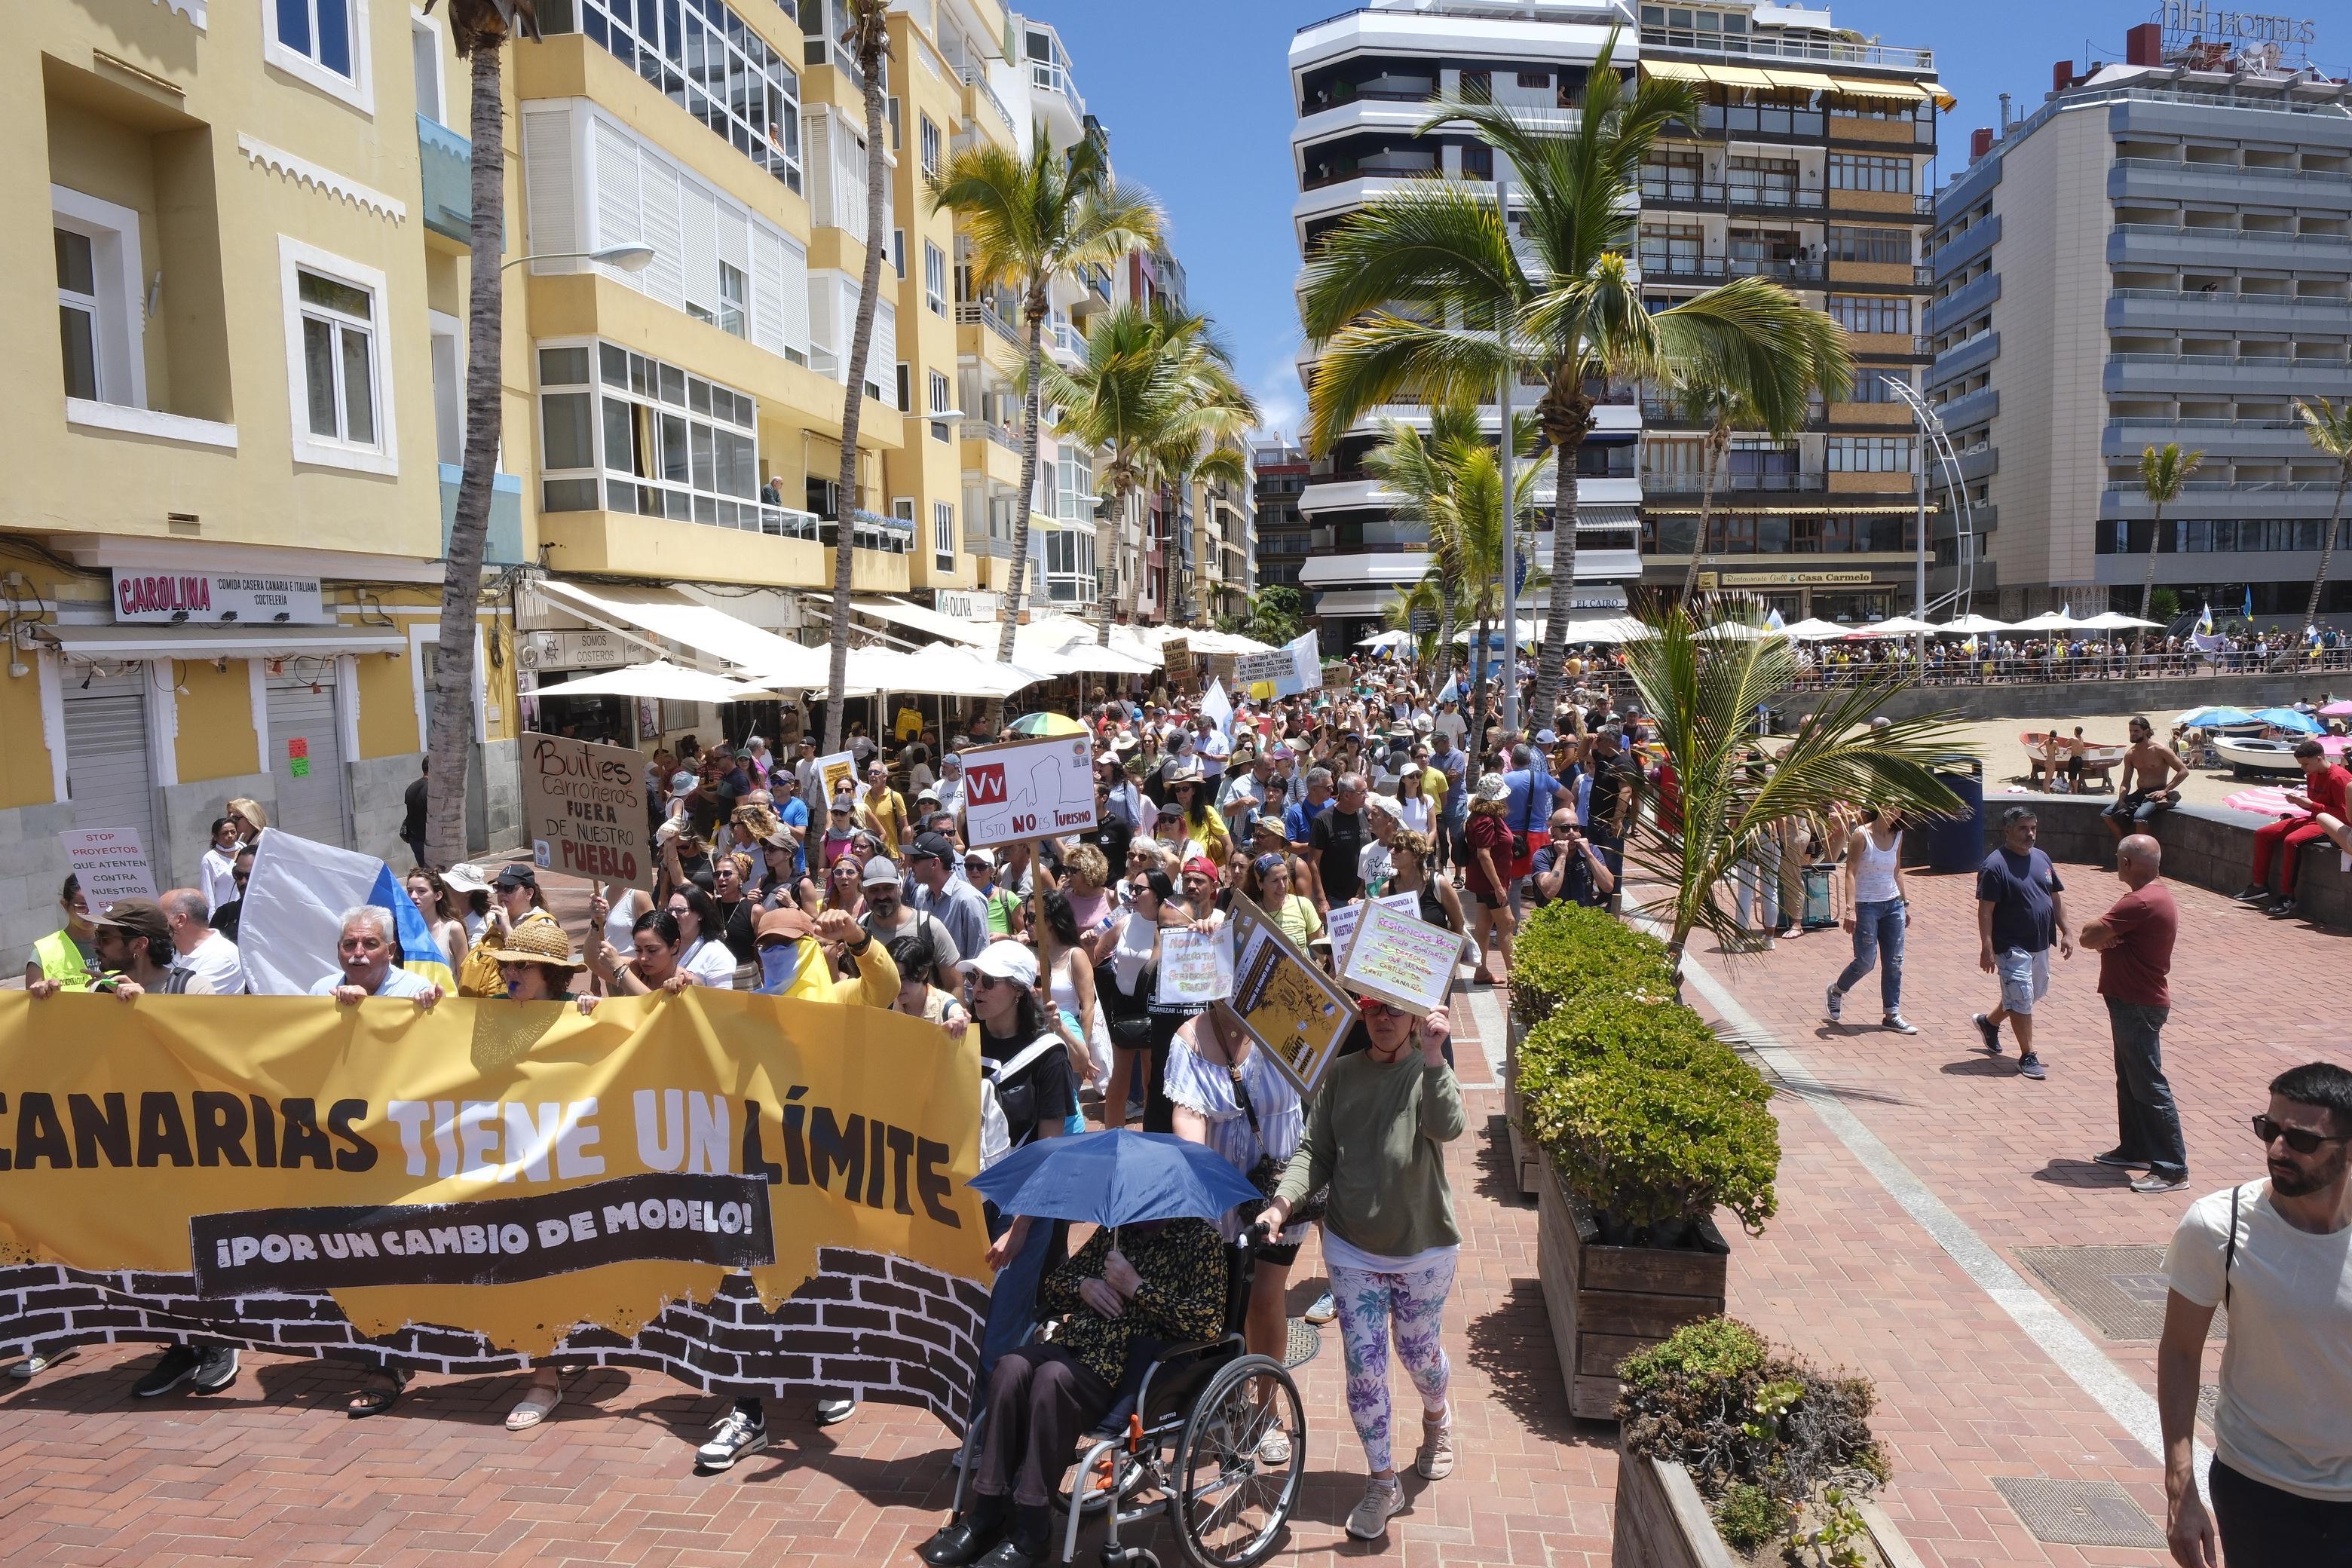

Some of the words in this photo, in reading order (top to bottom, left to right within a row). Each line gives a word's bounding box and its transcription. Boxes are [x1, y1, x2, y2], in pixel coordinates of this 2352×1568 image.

[2221, 11, 2316, 44] HOTELS
[1724, 574, 1768, 583] Restaurante
[1769, 574, 1788, 583] Grill
[242, 580, 264, 591] CASERA
[265, 580, 288, 592] CANARIA
[289, 581, 293, 592] E
[294, 581, 318, 593] ITALIANA
[118, 575, 211, 614] CAROLINA
[950, 596, 972, 617] OLIVA
[581, 635, 607, 647] SOMOS
[577, 651, 614, 663] COSTEROS
[533, 739, 632, 786] Buitres
[566, 800, 617, 824] FUERA
[1012, 813, 1037, 834] NO
[1039, 817, 1050, 830] ES
[86, 833, 115, 841] STOP
[546, 819, 568, 836] DE
[577, 822, 634, 846] NUESTRO
[72, 847, 138, 856] PROYECTOS
[73, 862, 96, 870] QUE
[99, 860, 147, 868] ATENTEN
[561, 839, 637, 881] PUEBLO
[93, 874, 137, 882] CONTRA
[91, 887, 148, 896] NUESTROS
[1344, 911, 1354, 919] ROBO
[1334, 923, 1354, 937] NUESTRAS
[1364, 954, 1374, 962] EL
[1148, 1006, 1175, 1014] ORGANIZAR
[1183, 1008, 1205, 1016] RABIA
[1298, 1048, 1314, 1074] CANARIAS
[387, 1095, 605, 1183] TIENE
[632, 1089, 730, 1175] UN
[743, 1085, 961, 1229] LÍMITE
[216, 1233, 319, 1269] ¡POR
[321, 1233, 379, 1260] UN
[381, 1222, 529, 1257] CAMBIO
[536, 1211, 597, 1249] DE
[602, 1199, 752, 1236] MODELO!
[1159, 1411, 1177, 1422] karma
